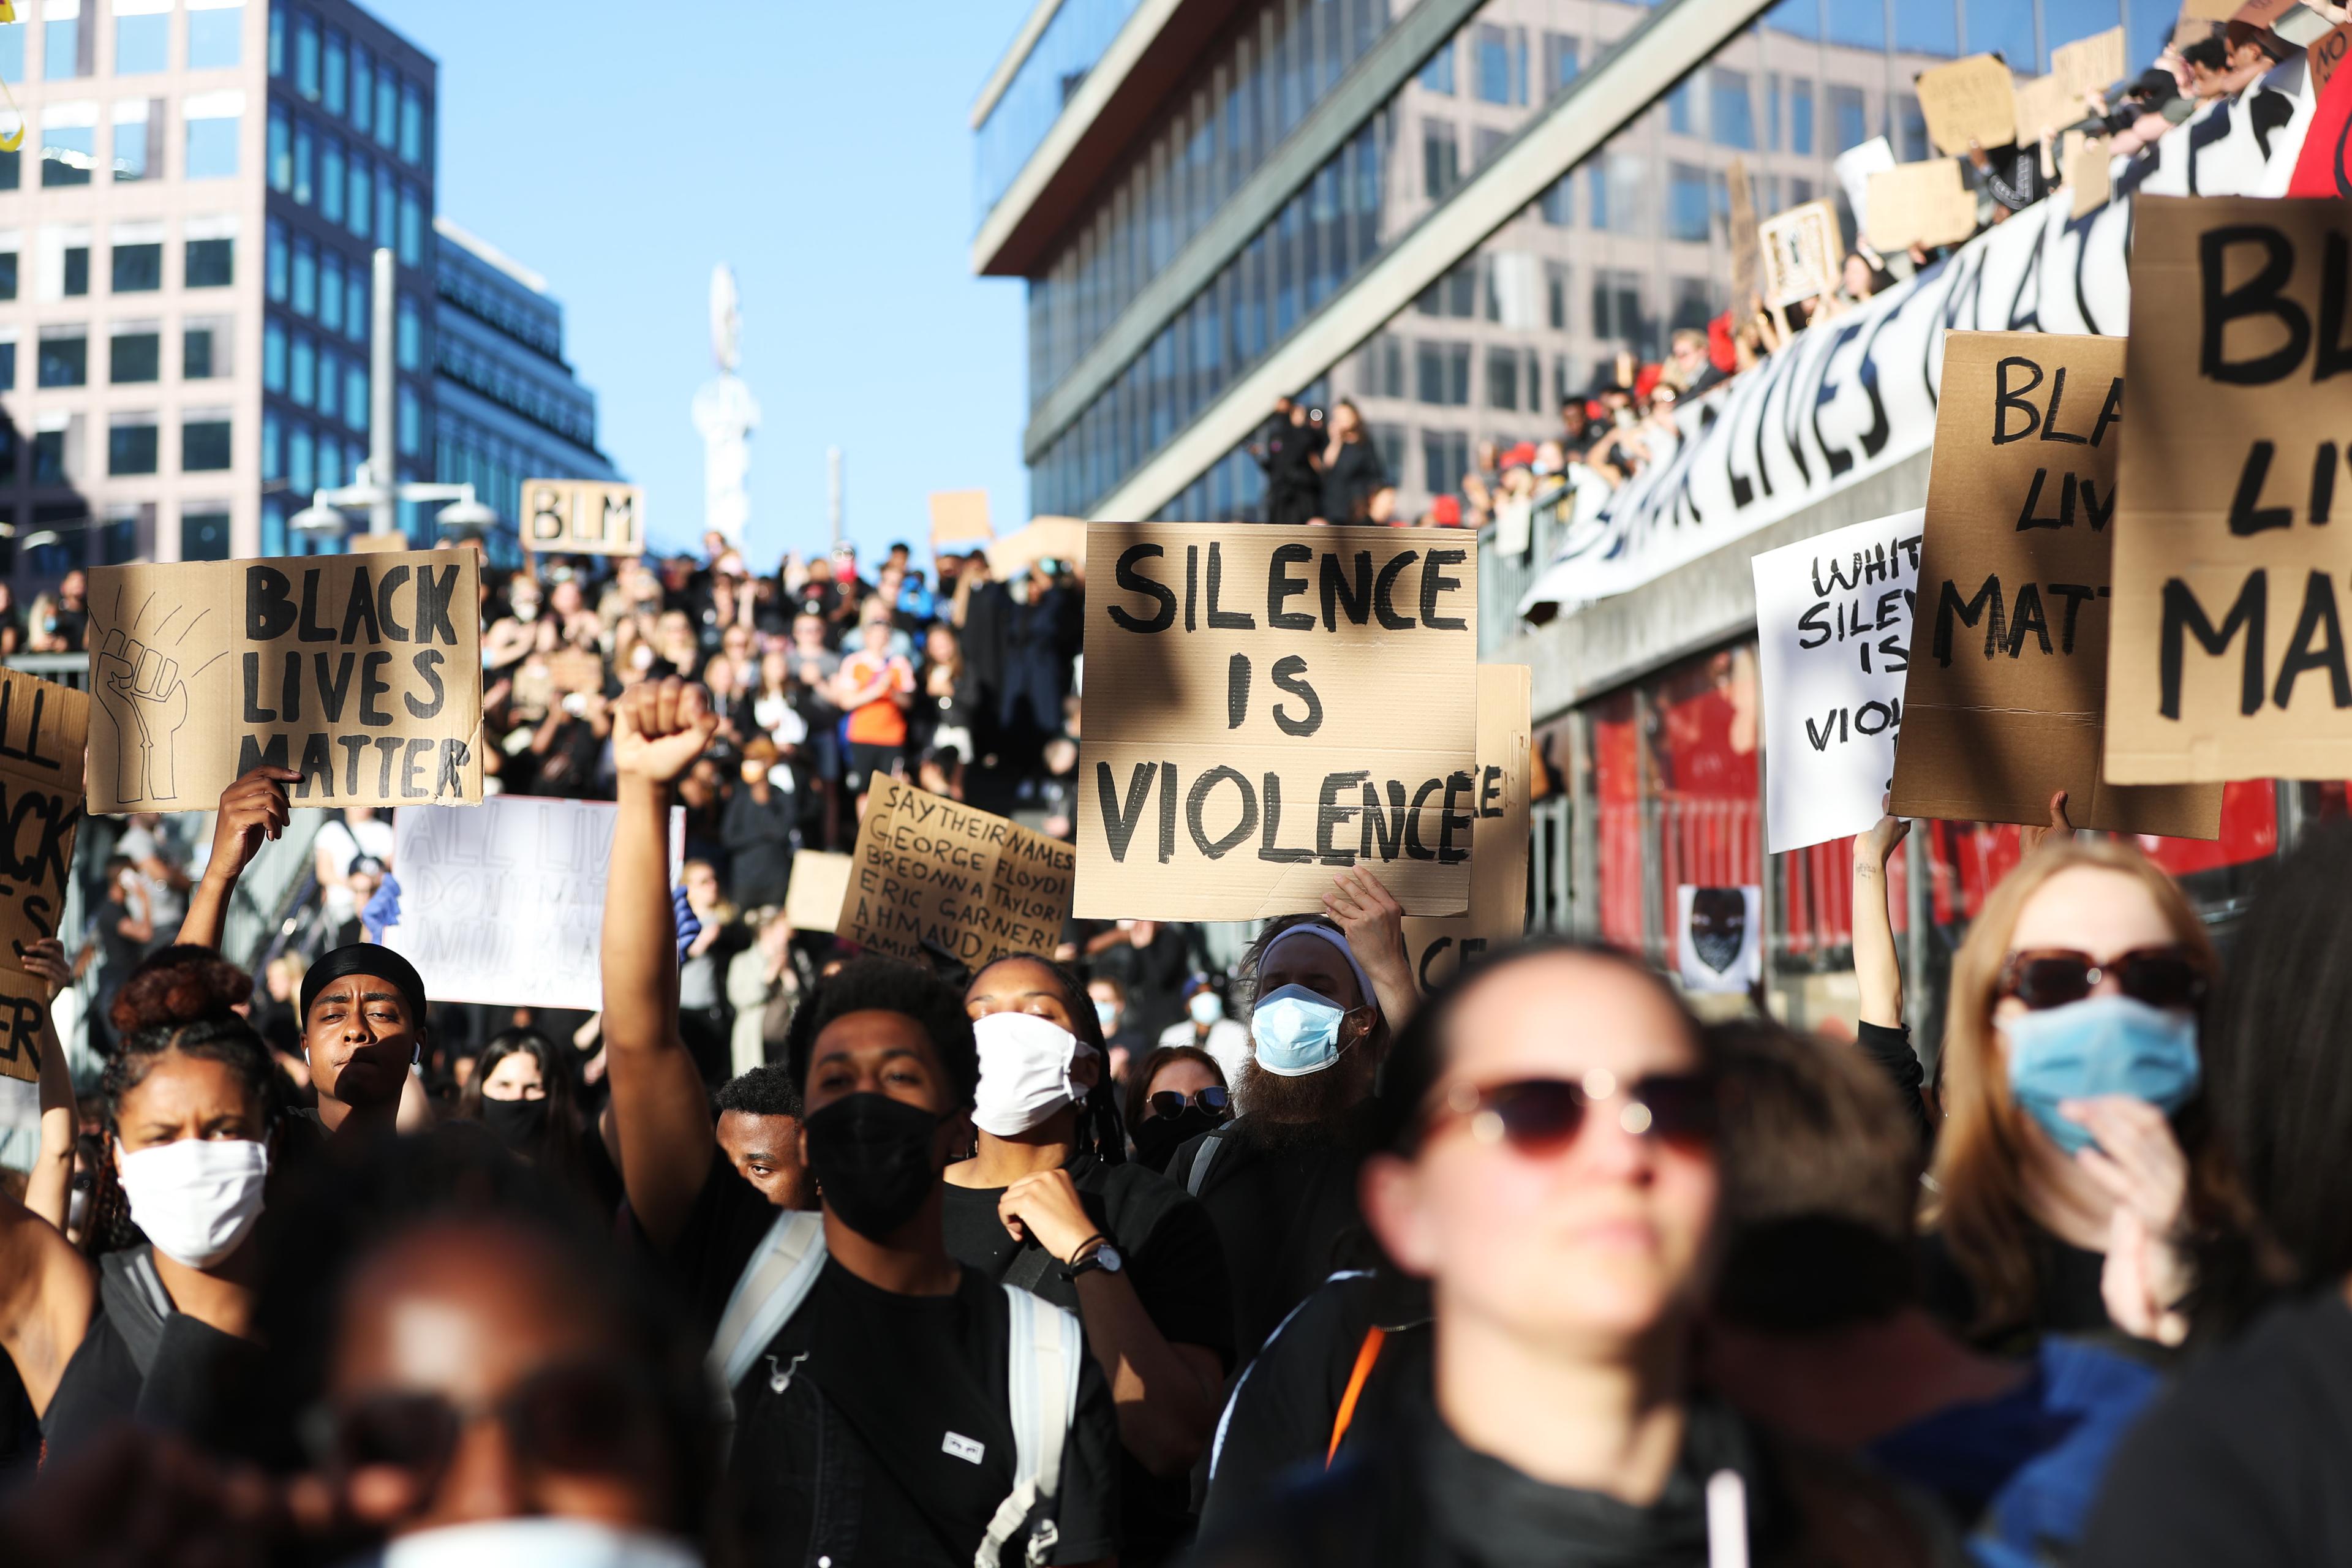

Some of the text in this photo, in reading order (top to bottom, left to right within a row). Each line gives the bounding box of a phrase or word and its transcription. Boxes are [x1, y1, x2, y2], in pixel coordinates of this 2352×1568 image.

[2315, 31, 2347, 74] NO
[1992, 356, 2125, 448] BLA
[533, 488, 633, 543] BLM
[2016, 467, 2117, 532] LIV
[2228, 440, 2352, 537] LI
[246, 565, 461, 646] BLACK
[1107, 541, 1469, 634] SILENCE
[1811, 535, 1923, 598] WHIT
[1797, 589, 1917, 649] SILE
[1860, 635, 1910, 674] IS
[1932, 573, 2111, 668] MAT
[243, 649, 445, 726] LIVES
[1227, 652, 1324, 737] IS
[1805, 697, 1902, 752] VIOL
[236, 733, 471, 799] MATTER
[536, 804, 614, 874] LIV
[884, 786, 1075, 871] SAY THEIR NAMES
[1096, 761, 1474, 866] VIOLENCE
[867, 843, 1063, 924] BREONNA TAYLOR!
[870, 813, 1066, 903] GEORGE FLOYD!
[855, 896, 982, 959] AHMAUD
[861, 869, 1054, 956] ERIC GARNER!
